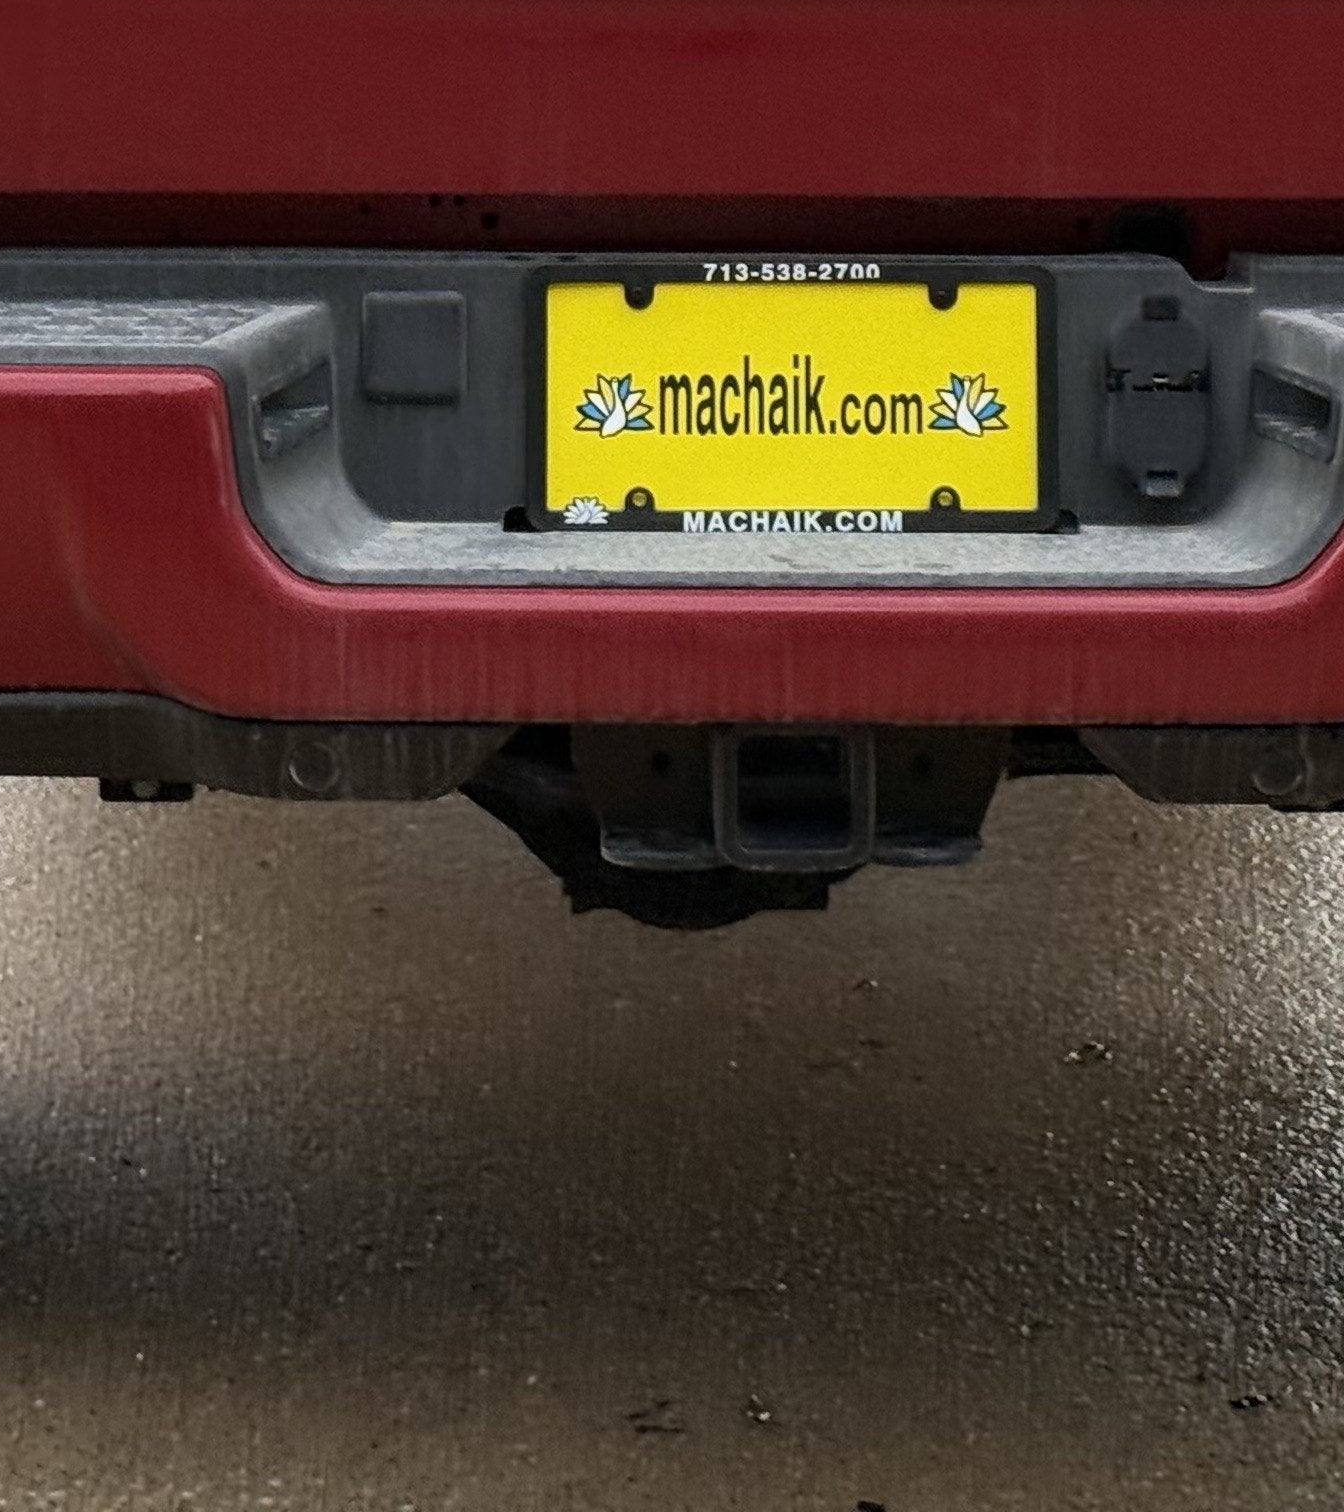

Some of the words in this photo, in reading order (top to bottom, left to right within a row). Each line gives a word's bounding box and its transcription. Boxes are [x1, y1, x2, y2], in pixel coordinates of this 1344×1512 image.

[702, 262, 882, 282] 713-538-2700
[658, 354, 924, 437] machaik.com
[682, 510, 905, 534] MACHAIK.COM
